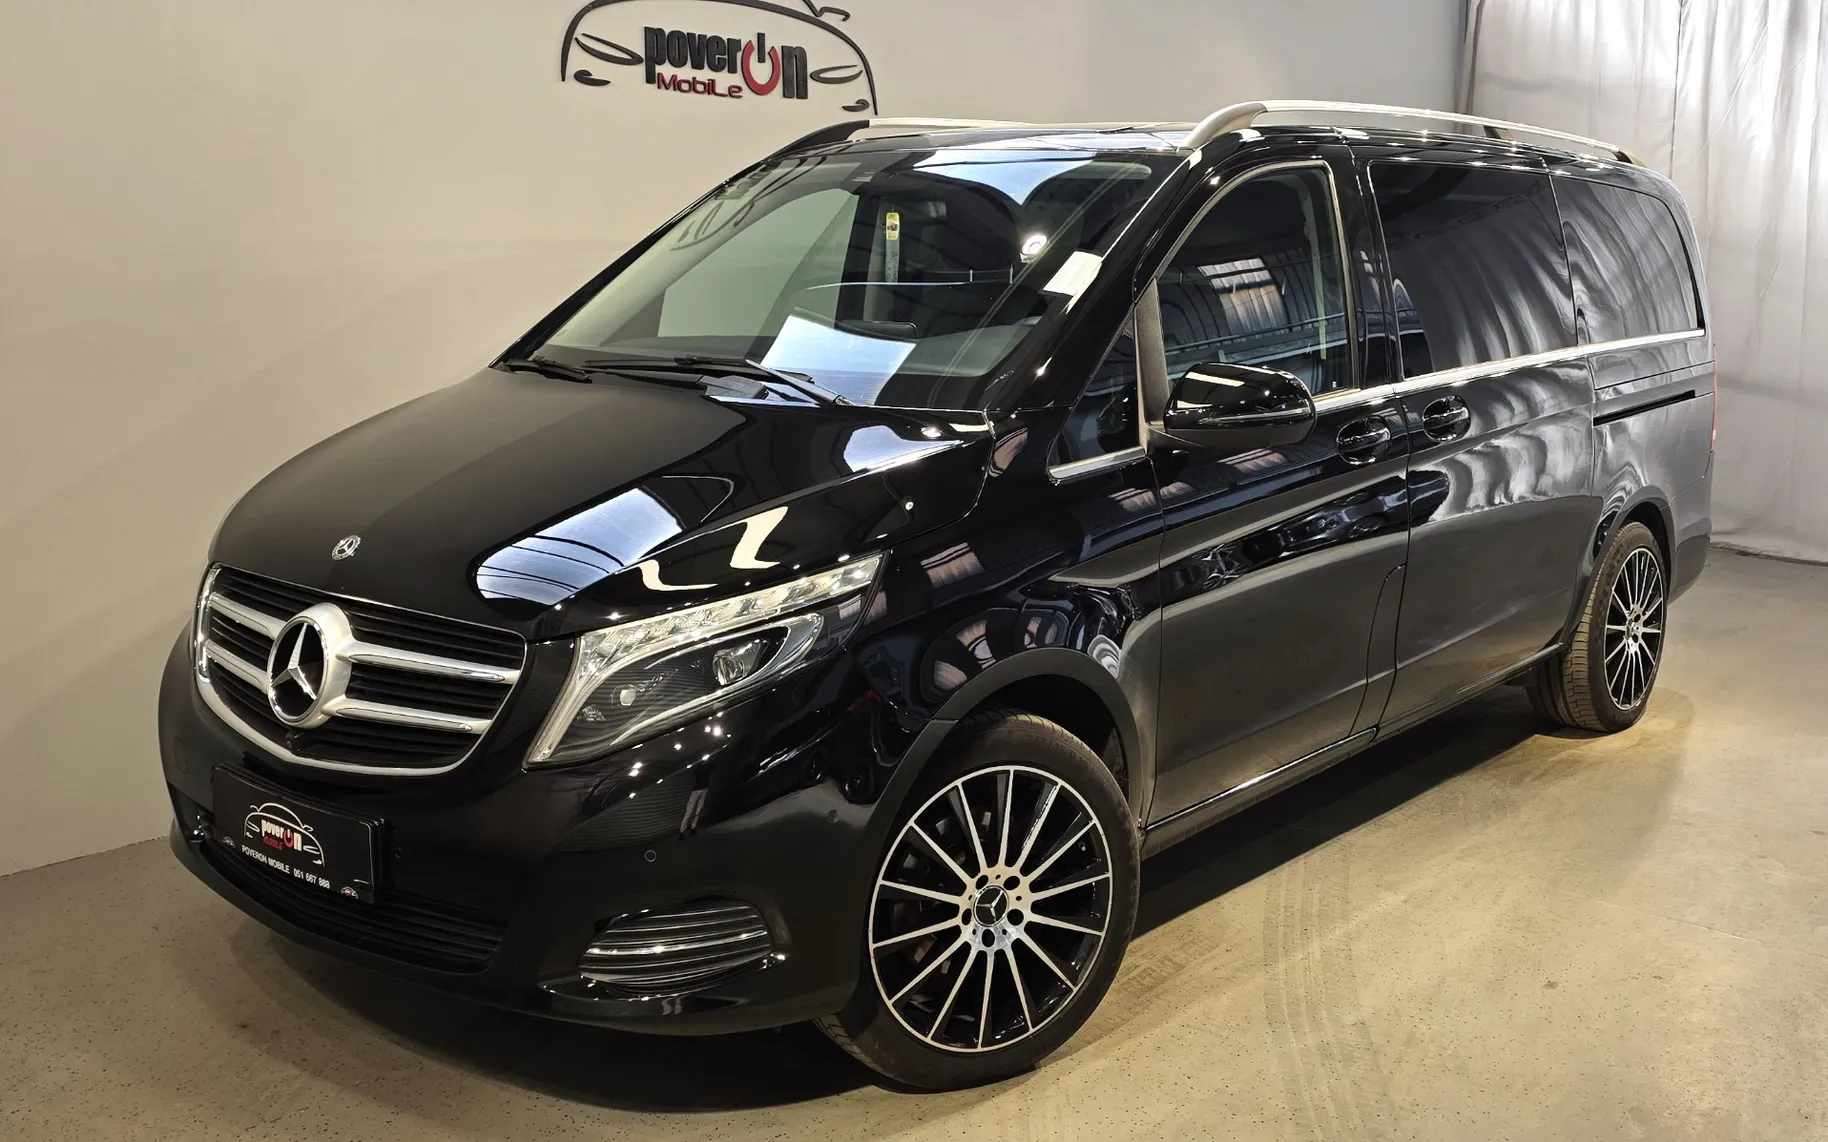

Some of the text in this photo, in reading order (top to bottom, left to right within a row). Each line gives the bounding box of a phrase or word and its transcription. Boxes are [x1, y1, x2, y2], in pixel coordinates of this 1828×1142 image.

[242, 845, 268, 864] POVERON
[268, 857, 291, 874] MOBILE
[293, 868, 304, 880] 051
